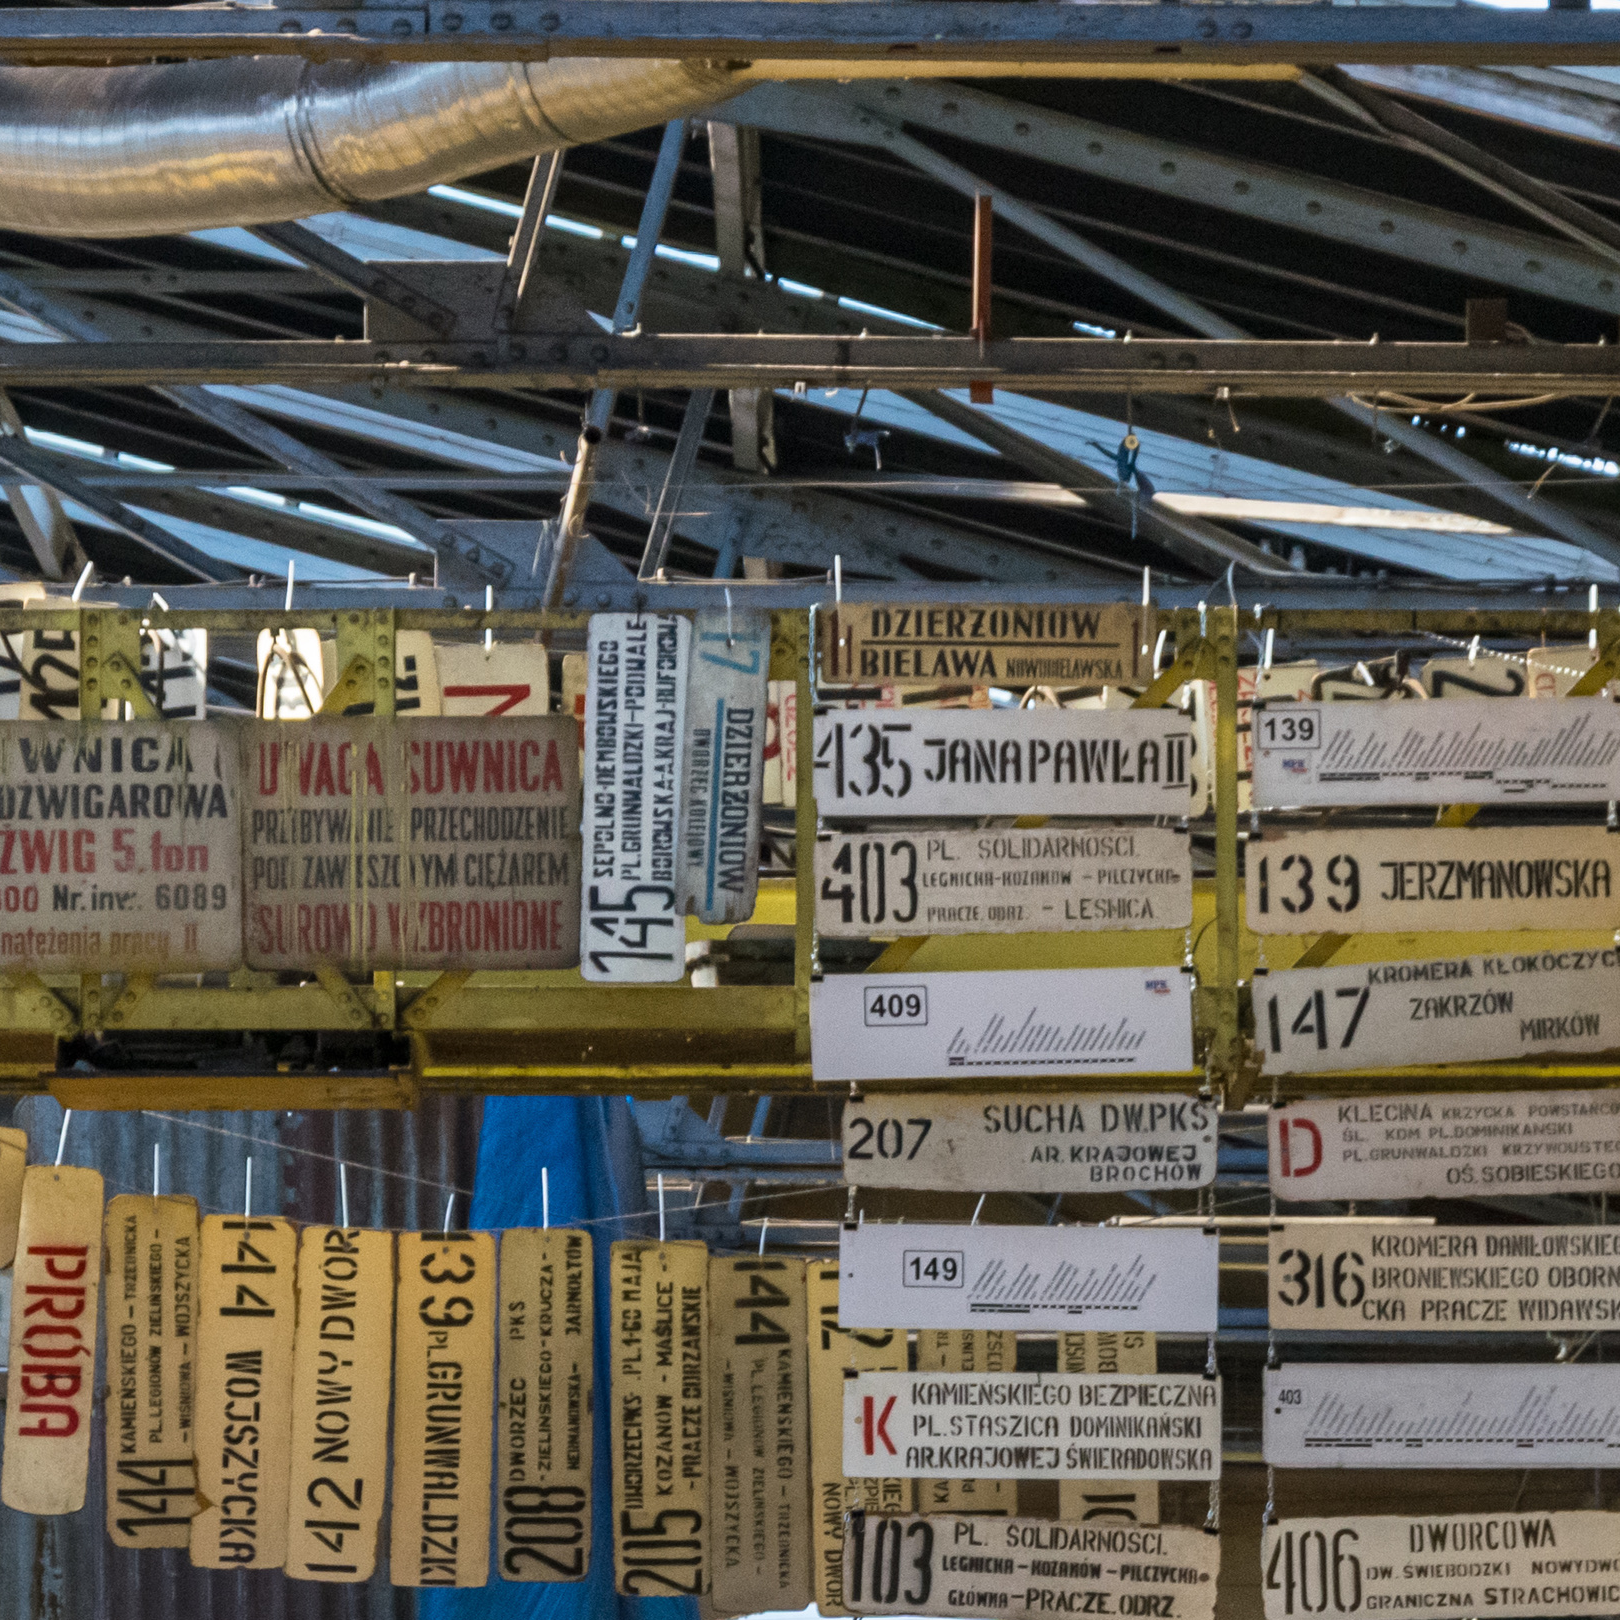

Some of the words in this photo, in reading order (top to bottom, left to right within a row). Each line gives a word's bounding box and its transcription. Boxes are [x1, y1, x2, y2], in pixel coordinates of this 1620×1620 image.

[860, 648, 998, 678] BIELAWA
[1264, 717, 1314, 741] 139
[259, 741, 384, 795] UWAGA
[404, 740, 564, 794] SUWNICA
[689, 728, 711, 795] DWORZEC
[815, 723, 913, 799] 435
[410, 806, 569, 841] PRZECHODZENIE
[685, 799, 710, 868] KOLEJOWY
[927, 839, 960, 860] PL.
[155, 884, 227, 910] 6089
[464, 850, 568, 888] CIĘŻAREM
[821, 840, 918, 924] 403
[1259, 854, 1359, 915] 139
[1380, 859, 1610, 901] JERZMANOWSKA
[590, 885, 675, 973] 145
[1368, 961, 1472, 986] KROMERA
[870, 993, 922, 1017] 409
[1267, 986, 1370, 1054] 147
[1409, 988, 1514, 1020] ZAKRZÓW
[1519, 1012, 1600, 1043] MIRKÓW
[848, 1118, 932, 1160] 207
[983, 1104, 1084, 1134] SUCHA
[1338, 1103, 1433, 1123] KLECINA
[1442, 1105, 1514, 1121] KRZYCKA
[1029, 1145, 1065, 1164] AR.
[1070, 1145, 1197, 1163] KRAJOWEJ
[1279, 1118, 1322, 1178] D
[124, 1215, 137, 1300] TRZEBNICKA
[220, 1221, 277, 1318] 144
[622, 1249, 641, 1302] MAJA
[909, 1257, 958, 1282] 149
[1371, 1235, 1477, 1258] KROMERA
[174, 1236, 191, 1337] WOJSZYCKA
[318, 1229, 359, 1341] DWÓR
[418, 1233, 476, 1328] 139
[733, 1261, 791, 1346] 144
[1278, 1248, 1366, 1310] 316
[1371, 1266, 1539, 1290] BRONIEWSKIEGO
[508, 1301, 526, 1340] PKS
[651, 1281, 673, 1367] MAŚLICE
[1361, 1299, 1407, 1322] CKA
[1420, 1298, 1508, 1322] PRACZE
[18, 1245, 91, 1438] PRÓBA
[313, 1350, 354, 1464] NOWY
[912, 1380, 1071, 1407] KAMIEŃSKIEGO
[1078, 1381, 1217, 1407] BEZPIECZNA
[1278, 1389, 1302, 1406] 403
[509, 1378, 527, 1482] DWORZEC
[862, 1394, 898, 1456] K
[1069, 1410, 1202, 1439] DOMINIKAŃSKI
[218, 1349, 263, 1563] WOJSZYCKA
[1066, 1442, 1213, 1471] ŚWIERADOWSKA
[116, 1459, 195, 1537] 144
[304, 1477, 363, 1574] 142
[724, 1464, 741, 1568] WOJSZYCKA
[503, 1486, 586, 1576] 208
[621, 1509, 703, 1595] 205
[955, 1522, 987, 1546] PL.
[1409, 1519, 1557, 1553] DWORCOWA
[850, 1519, 934, 1605] 103
[1266, 1527, 1363, 1616] 406
[1366, 1592, 1473, 1610] GRANICZNA
